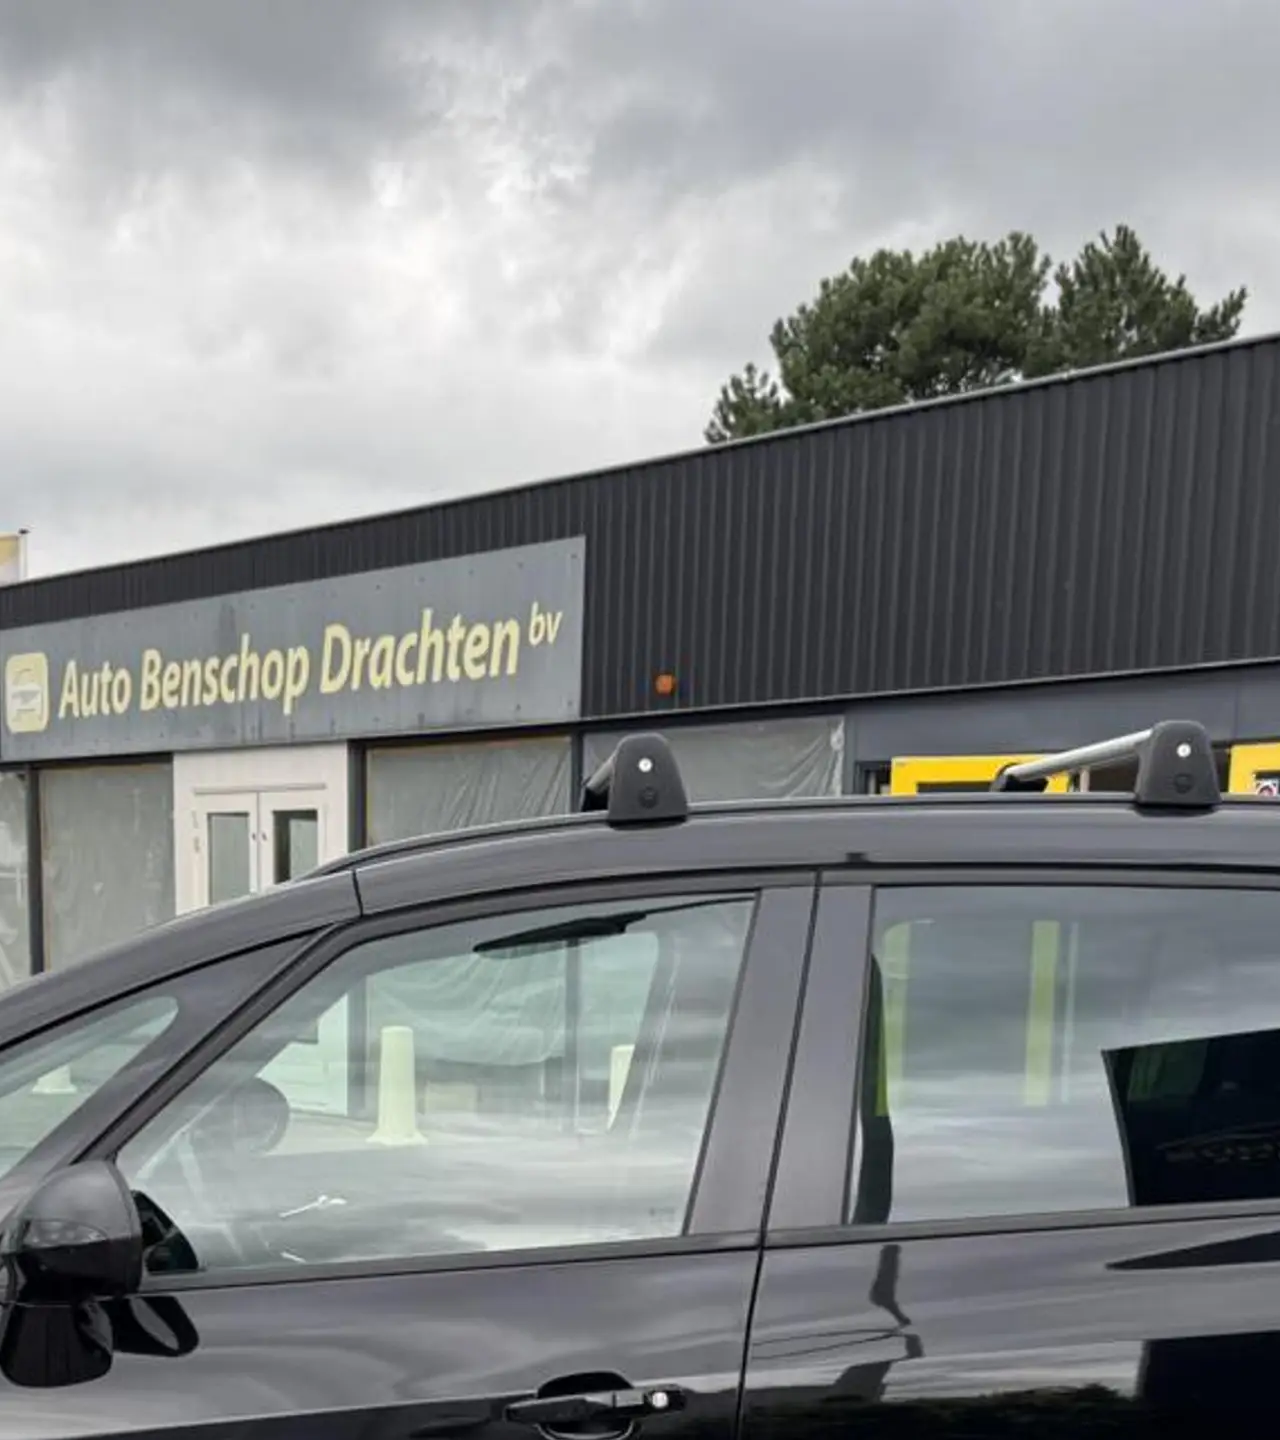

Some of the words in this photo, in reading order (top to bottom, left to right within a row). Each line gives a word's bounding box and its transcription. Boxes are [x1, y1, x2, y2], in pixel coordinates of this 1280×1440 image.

[59, 660, 132, 720] Auto
[139, 633, 310, 714] Benschop
[320, 608, 520, 694] Drachten
[528, 601, 564, 646] bv
